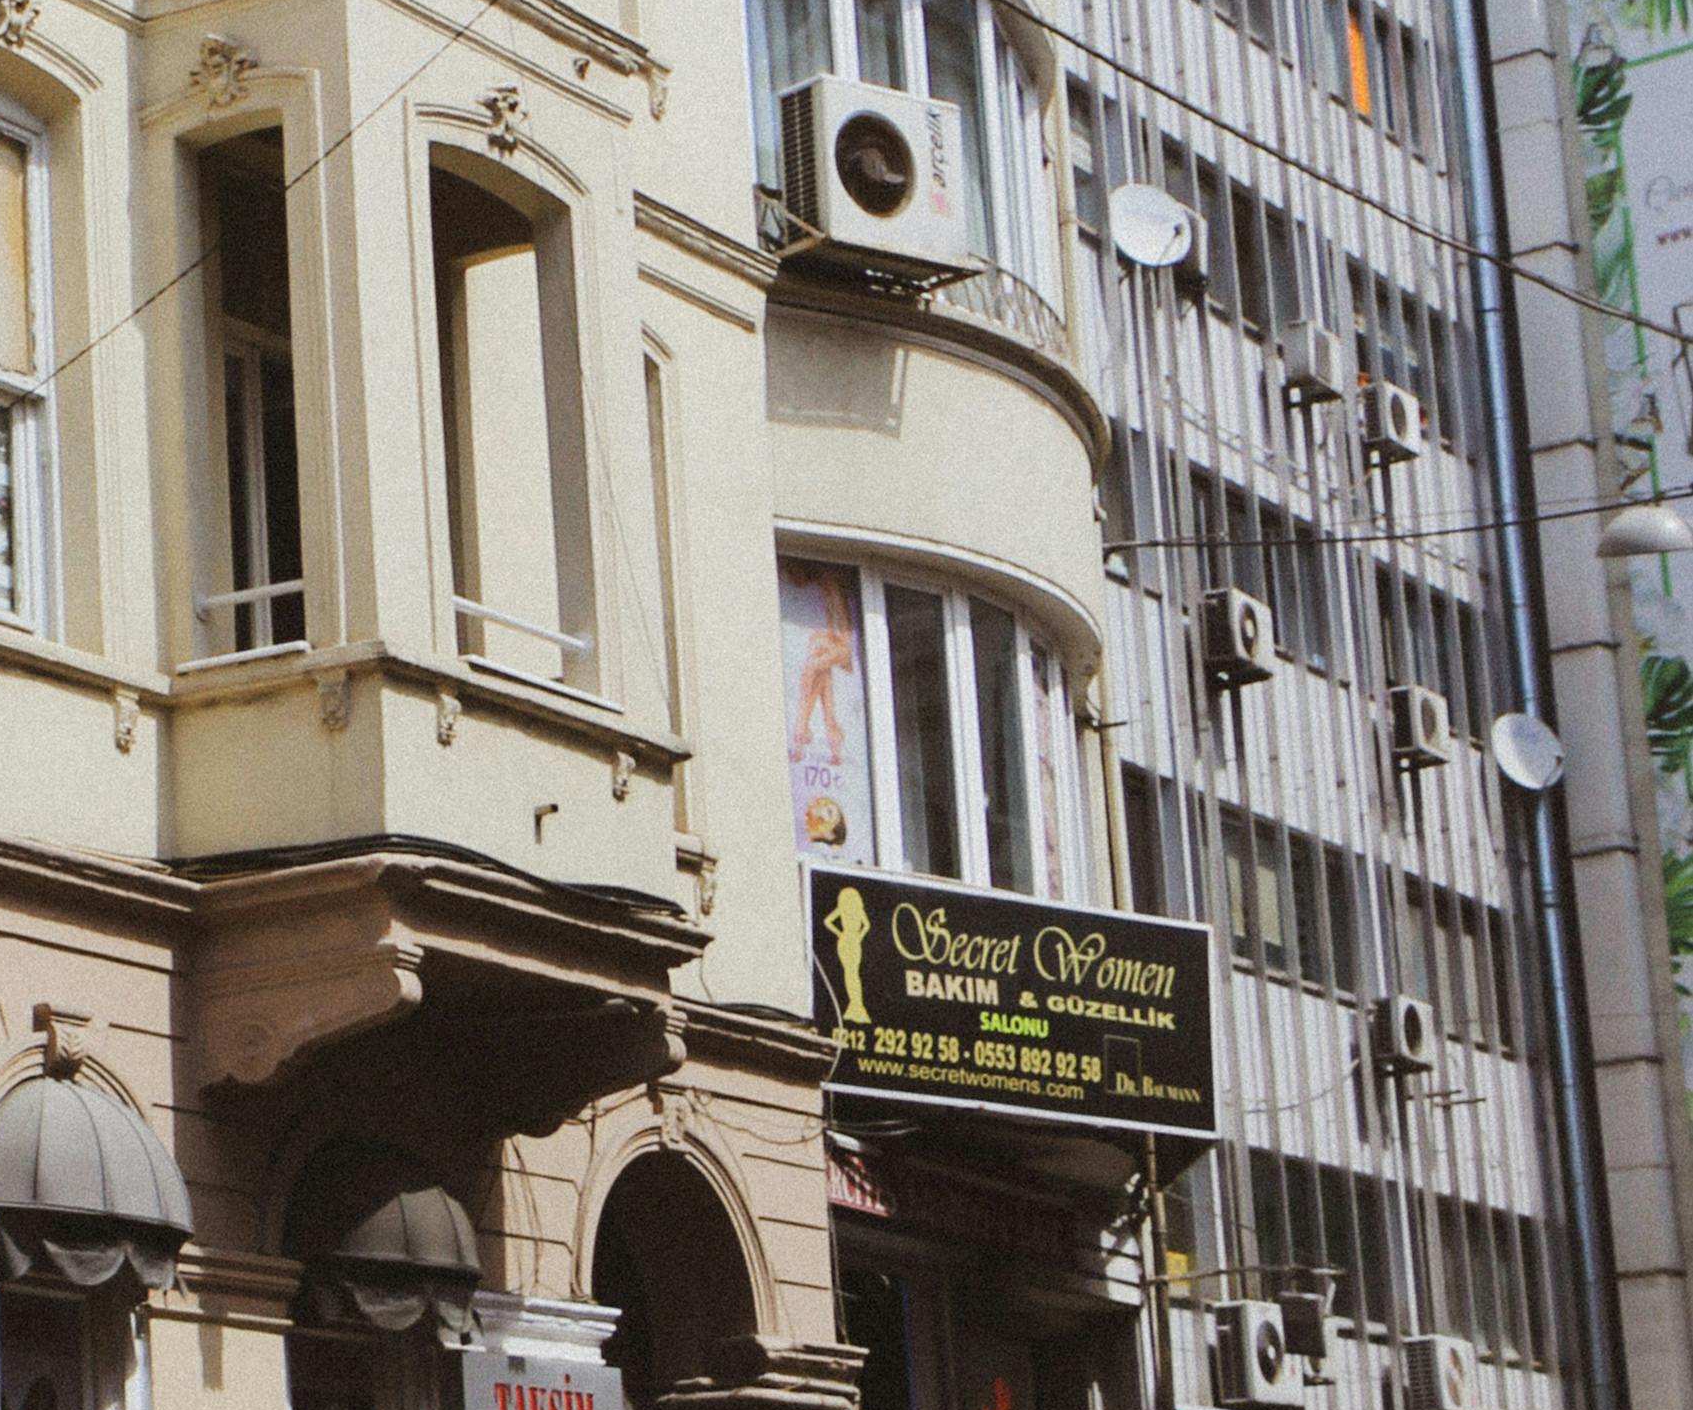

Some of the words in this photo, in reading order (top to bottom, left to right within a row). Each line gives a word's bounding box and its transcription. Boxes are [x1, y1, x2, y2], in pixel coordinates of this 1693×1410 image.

[892, 902, 1021, 975] Secret
[1033, 925, 1176, 998] Women
[905, 970, 999, 1006] BAKIM
[1019, 990, 1038, 1009] &
[1047, 994, 1176, 1031] GÜZELLİK
[980, 1011, 1049, 1038] SALONU
[858, 1057, 1085, 1100] www.secretwomens.com
[874, 1026, 907, 1056] 292
[911, 1032, 933, 1059] 92
[938, 1035, 959, 1063] 58
[974, 1040, 1016, 1070] 0553
[1020, 1047, 1052, 1075] 892
[1055, 1052, 1077, 1079] 92
[1081, 1055, 1102, 1083] 58
